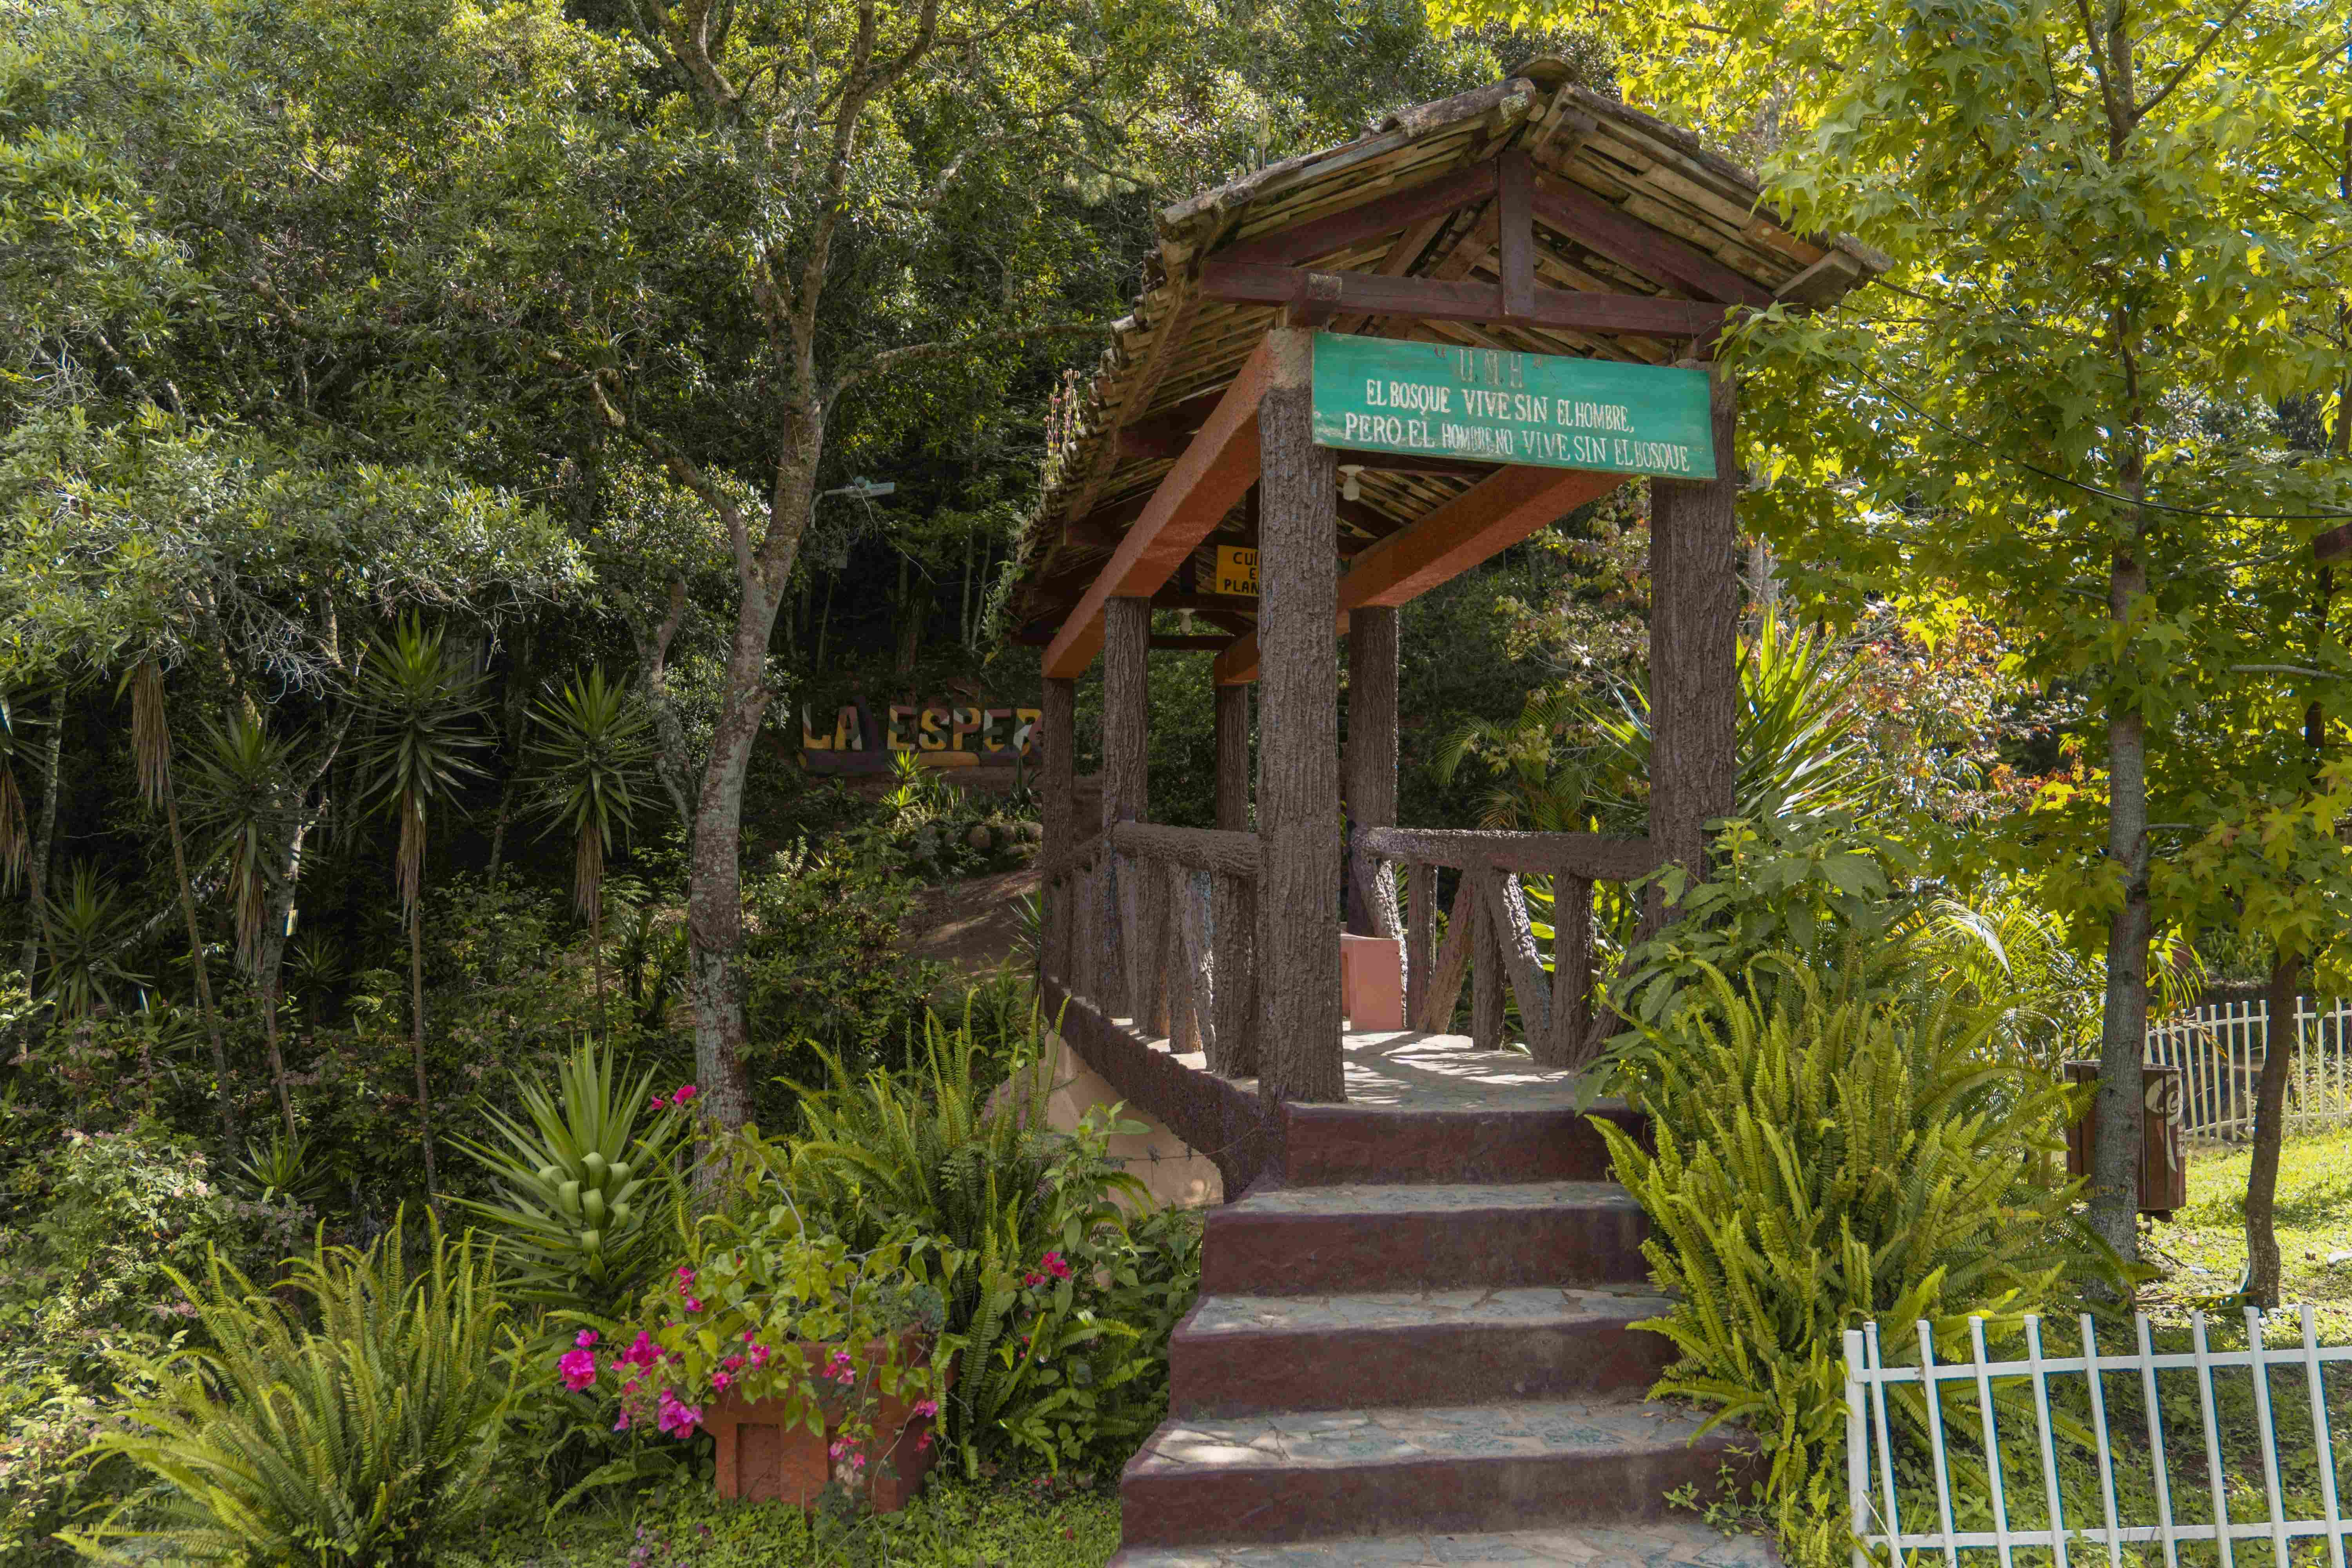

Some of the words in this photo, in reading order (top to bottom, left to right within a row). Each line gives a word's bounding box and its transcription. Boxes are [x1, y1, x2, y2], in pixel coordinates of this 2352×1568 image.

[1367, 379, 1387, 406] EL
[1390, 381, 1451, 415] BOSQUE
[1461, 389, 1512, 420] VIVE
[1514, 394, 1548, 423] SIN
[1557, 399, 1573, 426] EL
[1575, 401, 1635, 433] HOMBRE,
[1345, 412, 1402, 445] PERO
[1407, 419, 1436, 448] EL
[1495, 428, 1514, 455] NO
[1521, 430, 1570, 461] VIVE
[1573, 435, 1607, 464] SIN
[1613, 438, 1633, 466] EL
[1634, 441, 1690, 472] BOSQUE
[802, 704, 863, 750] LA
